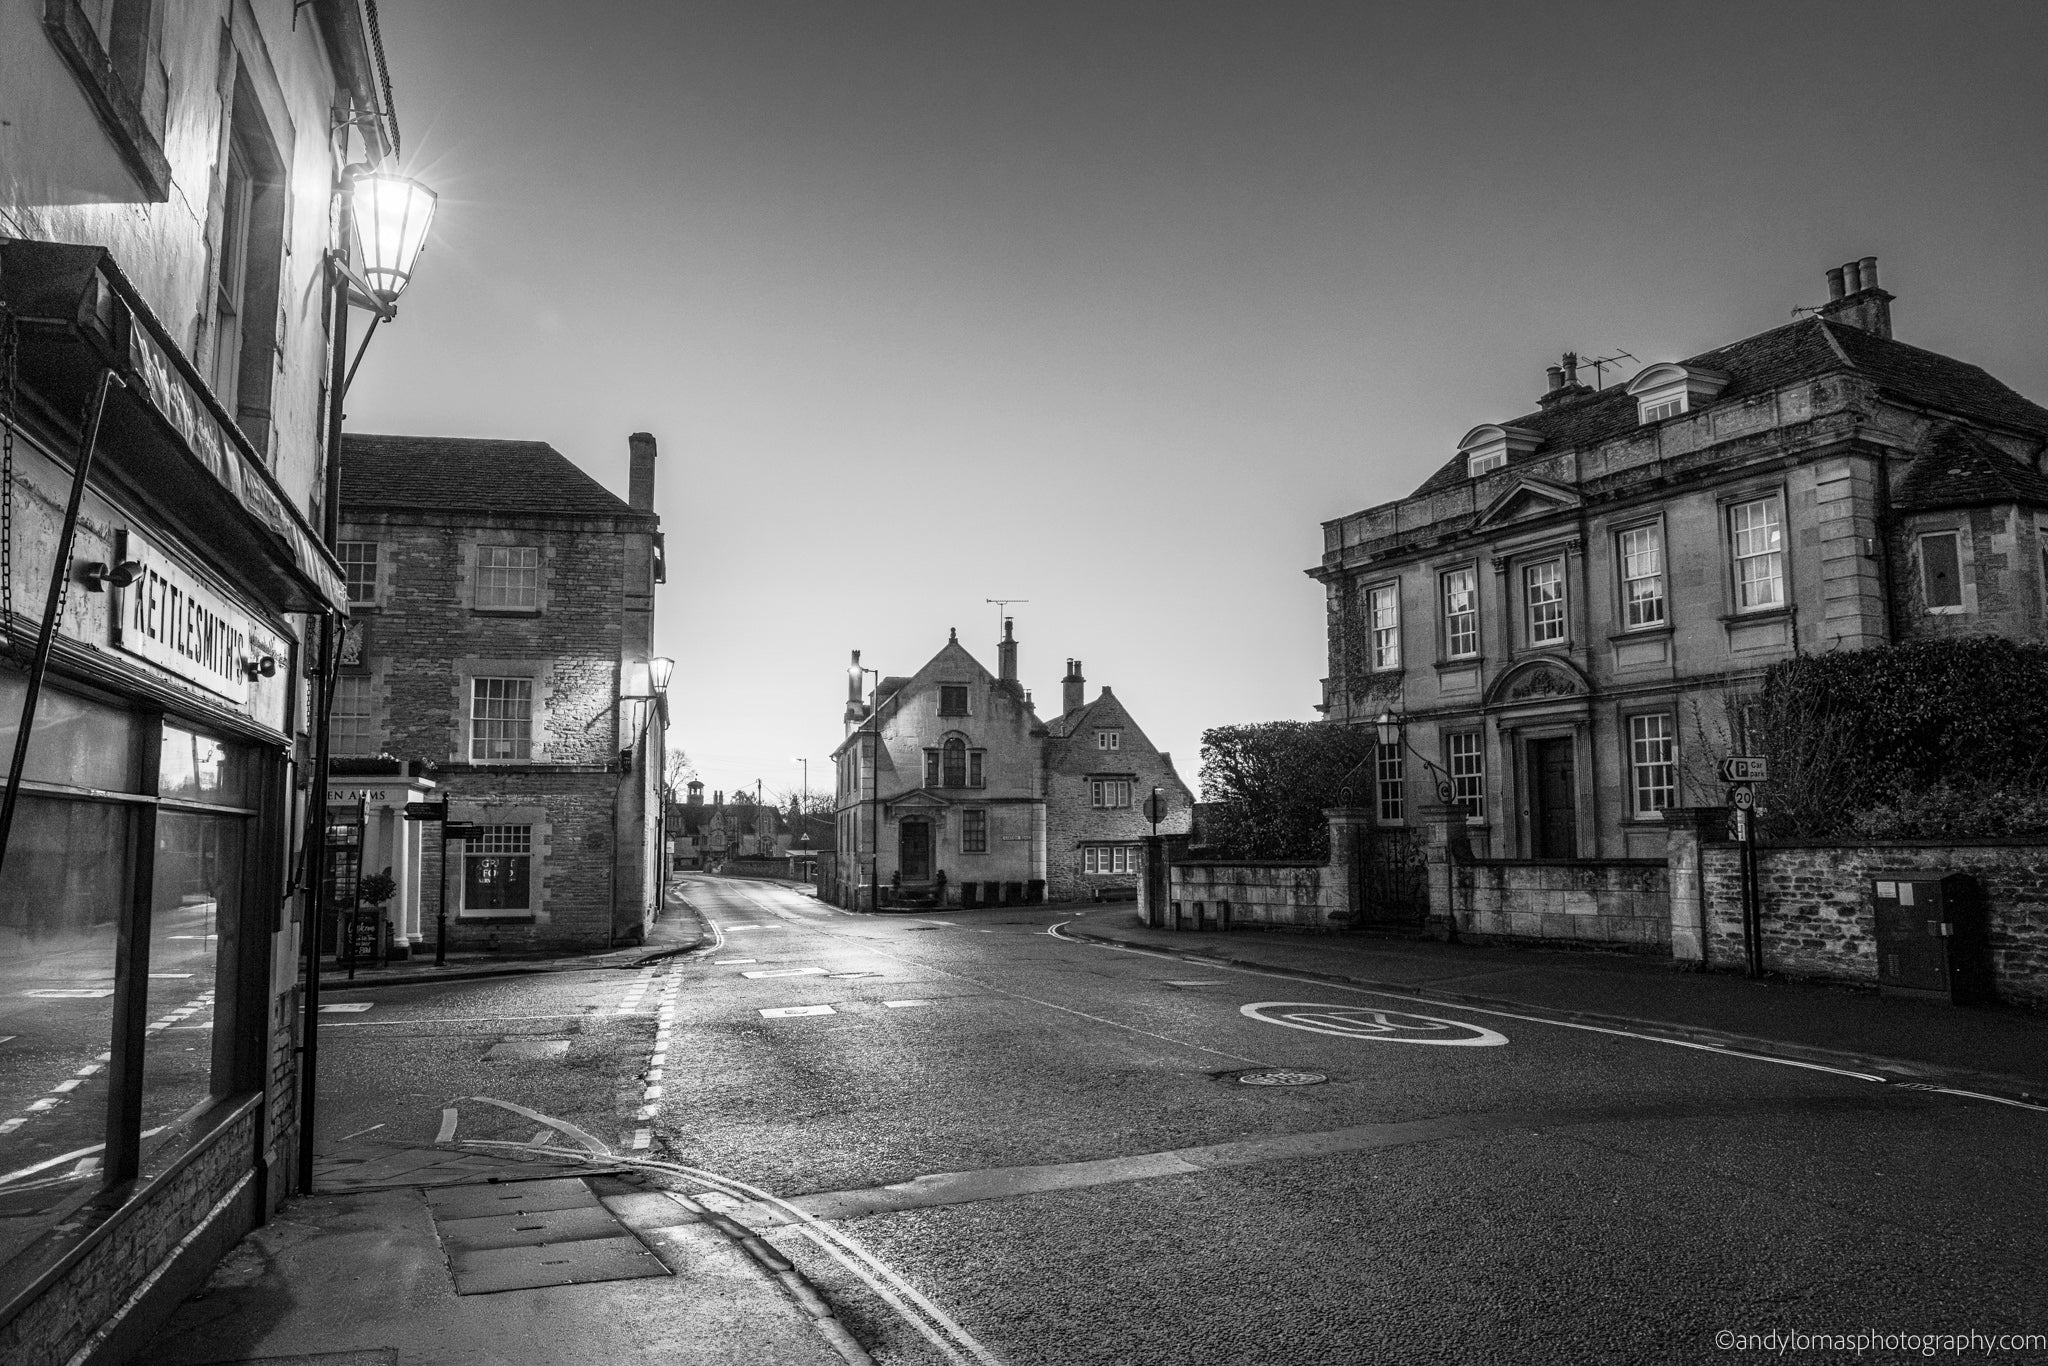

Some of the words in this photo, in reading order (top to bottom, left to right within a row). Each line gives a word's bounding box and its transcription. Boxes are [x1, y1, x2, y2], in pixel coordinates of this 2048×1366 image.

[134, 563, 244, 686] KETTLESMITH'S
[1739, 763, 1746, 776] P
[348, 790, 386, 800] AMS
[1736, 792, 1751, 804] 20
